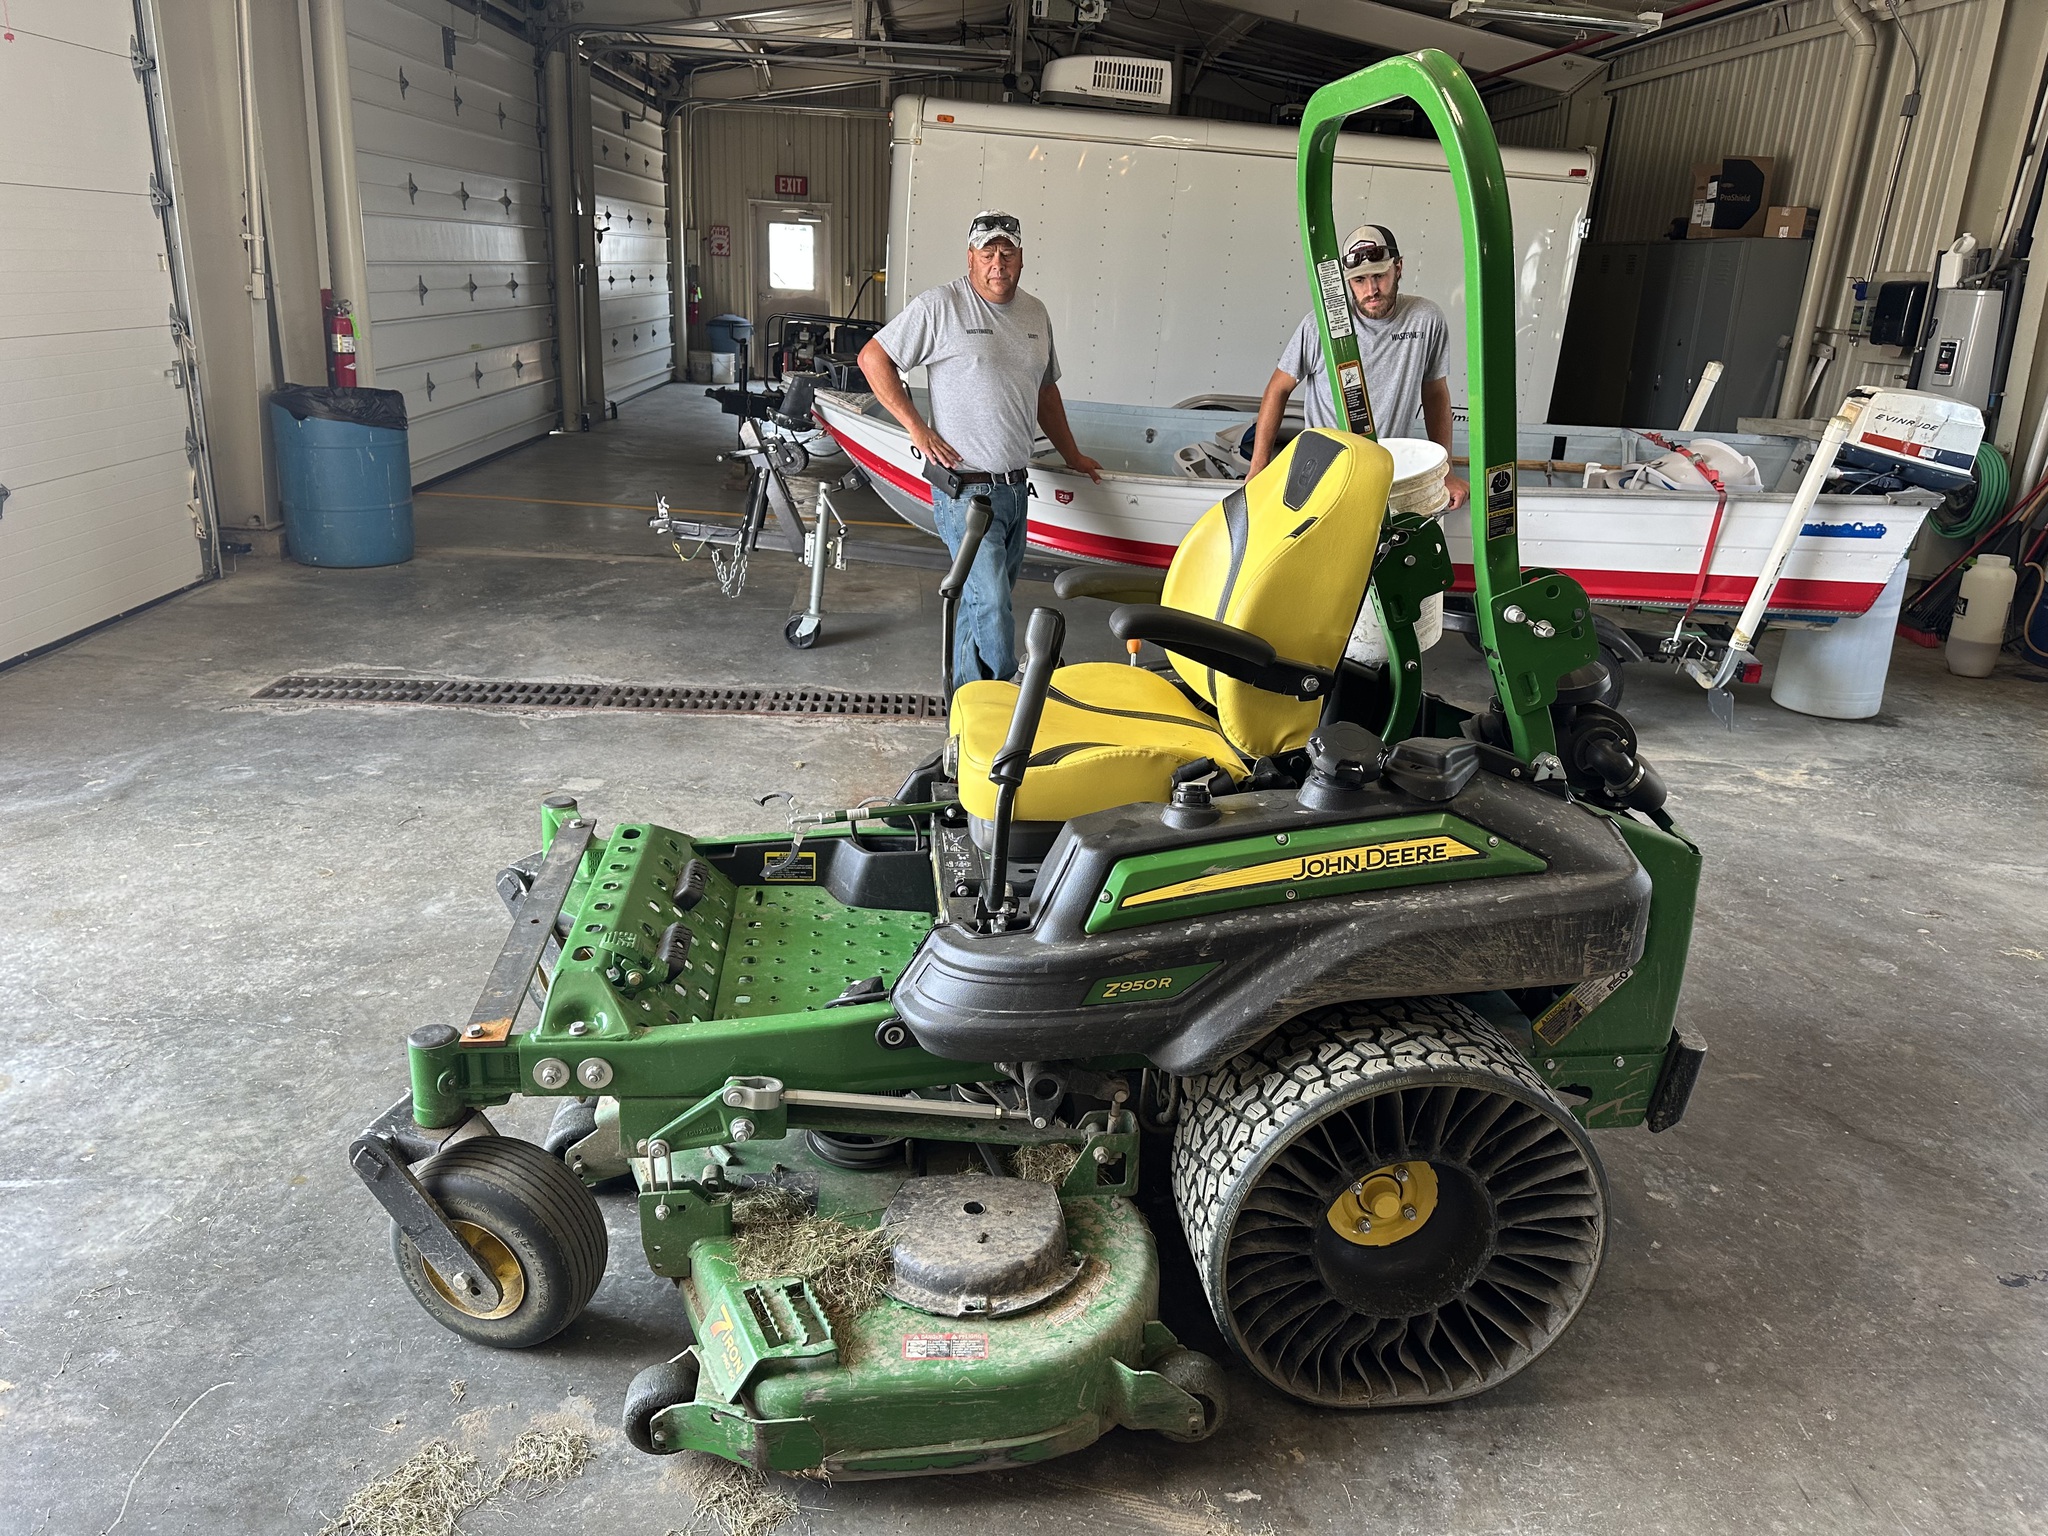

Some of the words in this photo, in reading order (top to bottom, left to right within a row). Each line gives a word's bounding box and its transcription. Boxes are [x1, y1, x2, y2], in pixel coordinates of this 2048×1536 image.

[779, 177, 803, 193] EXIT
[1720, 193, 1751, 202] ProShield
[1293, 854, 1360, 880] JOHN
[1366, 843, 1448, 868] DEERE
[1102, 977, 1172, 998] Z950R
[1218, 1178, 1249, 1241] MICHELIN
